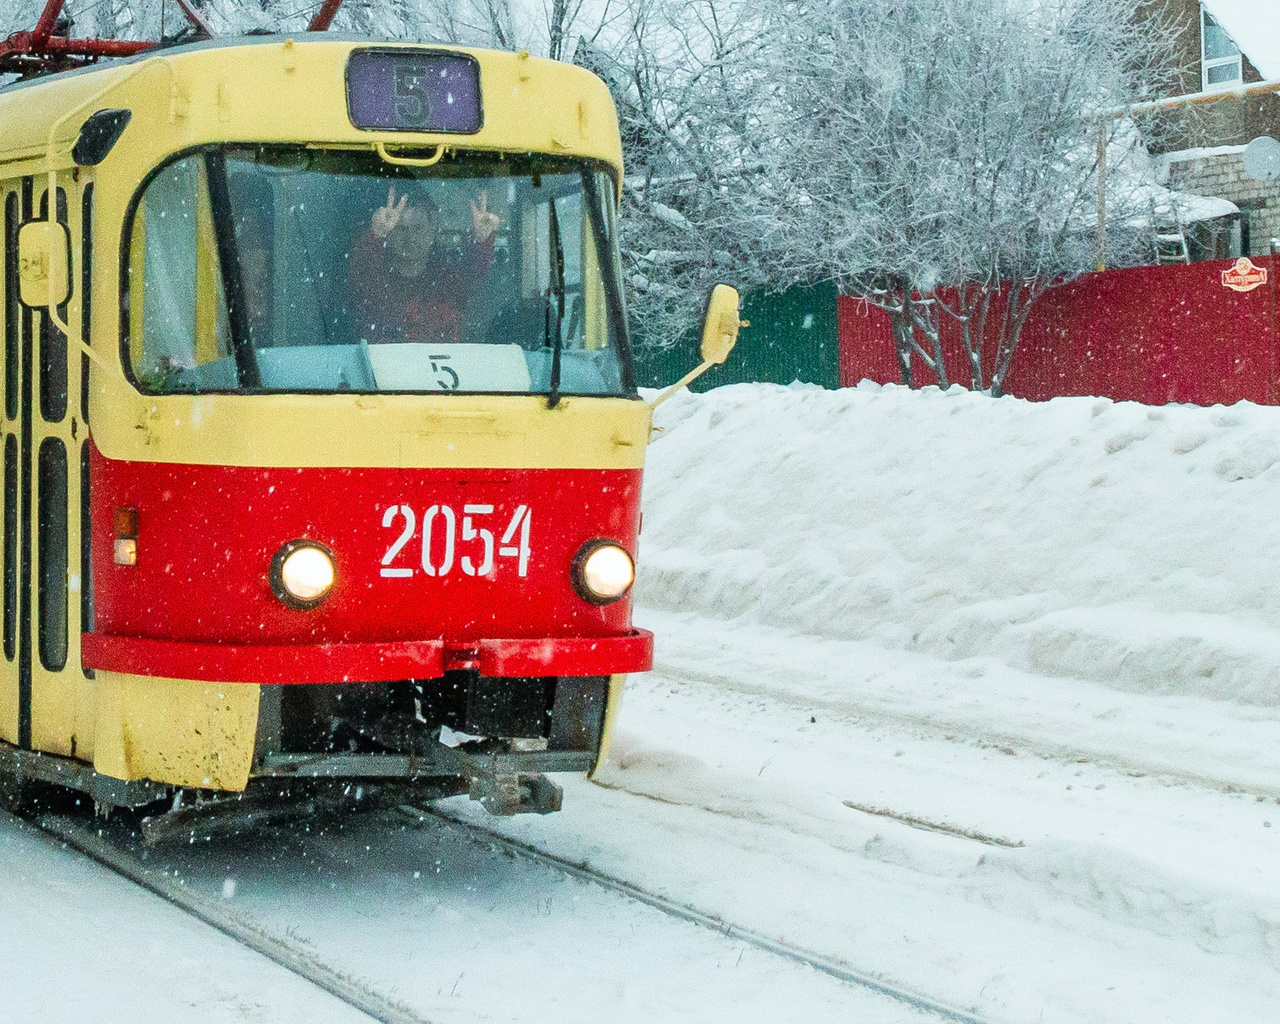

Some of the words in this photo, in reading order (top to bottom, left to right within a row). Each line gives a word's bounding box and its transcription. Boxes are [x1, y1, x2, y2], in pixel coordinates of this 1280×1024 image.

[395, 65, 432, 126] 5
[428, 355, 460, 390] 5
[380, 504, 532, 577] 2054
